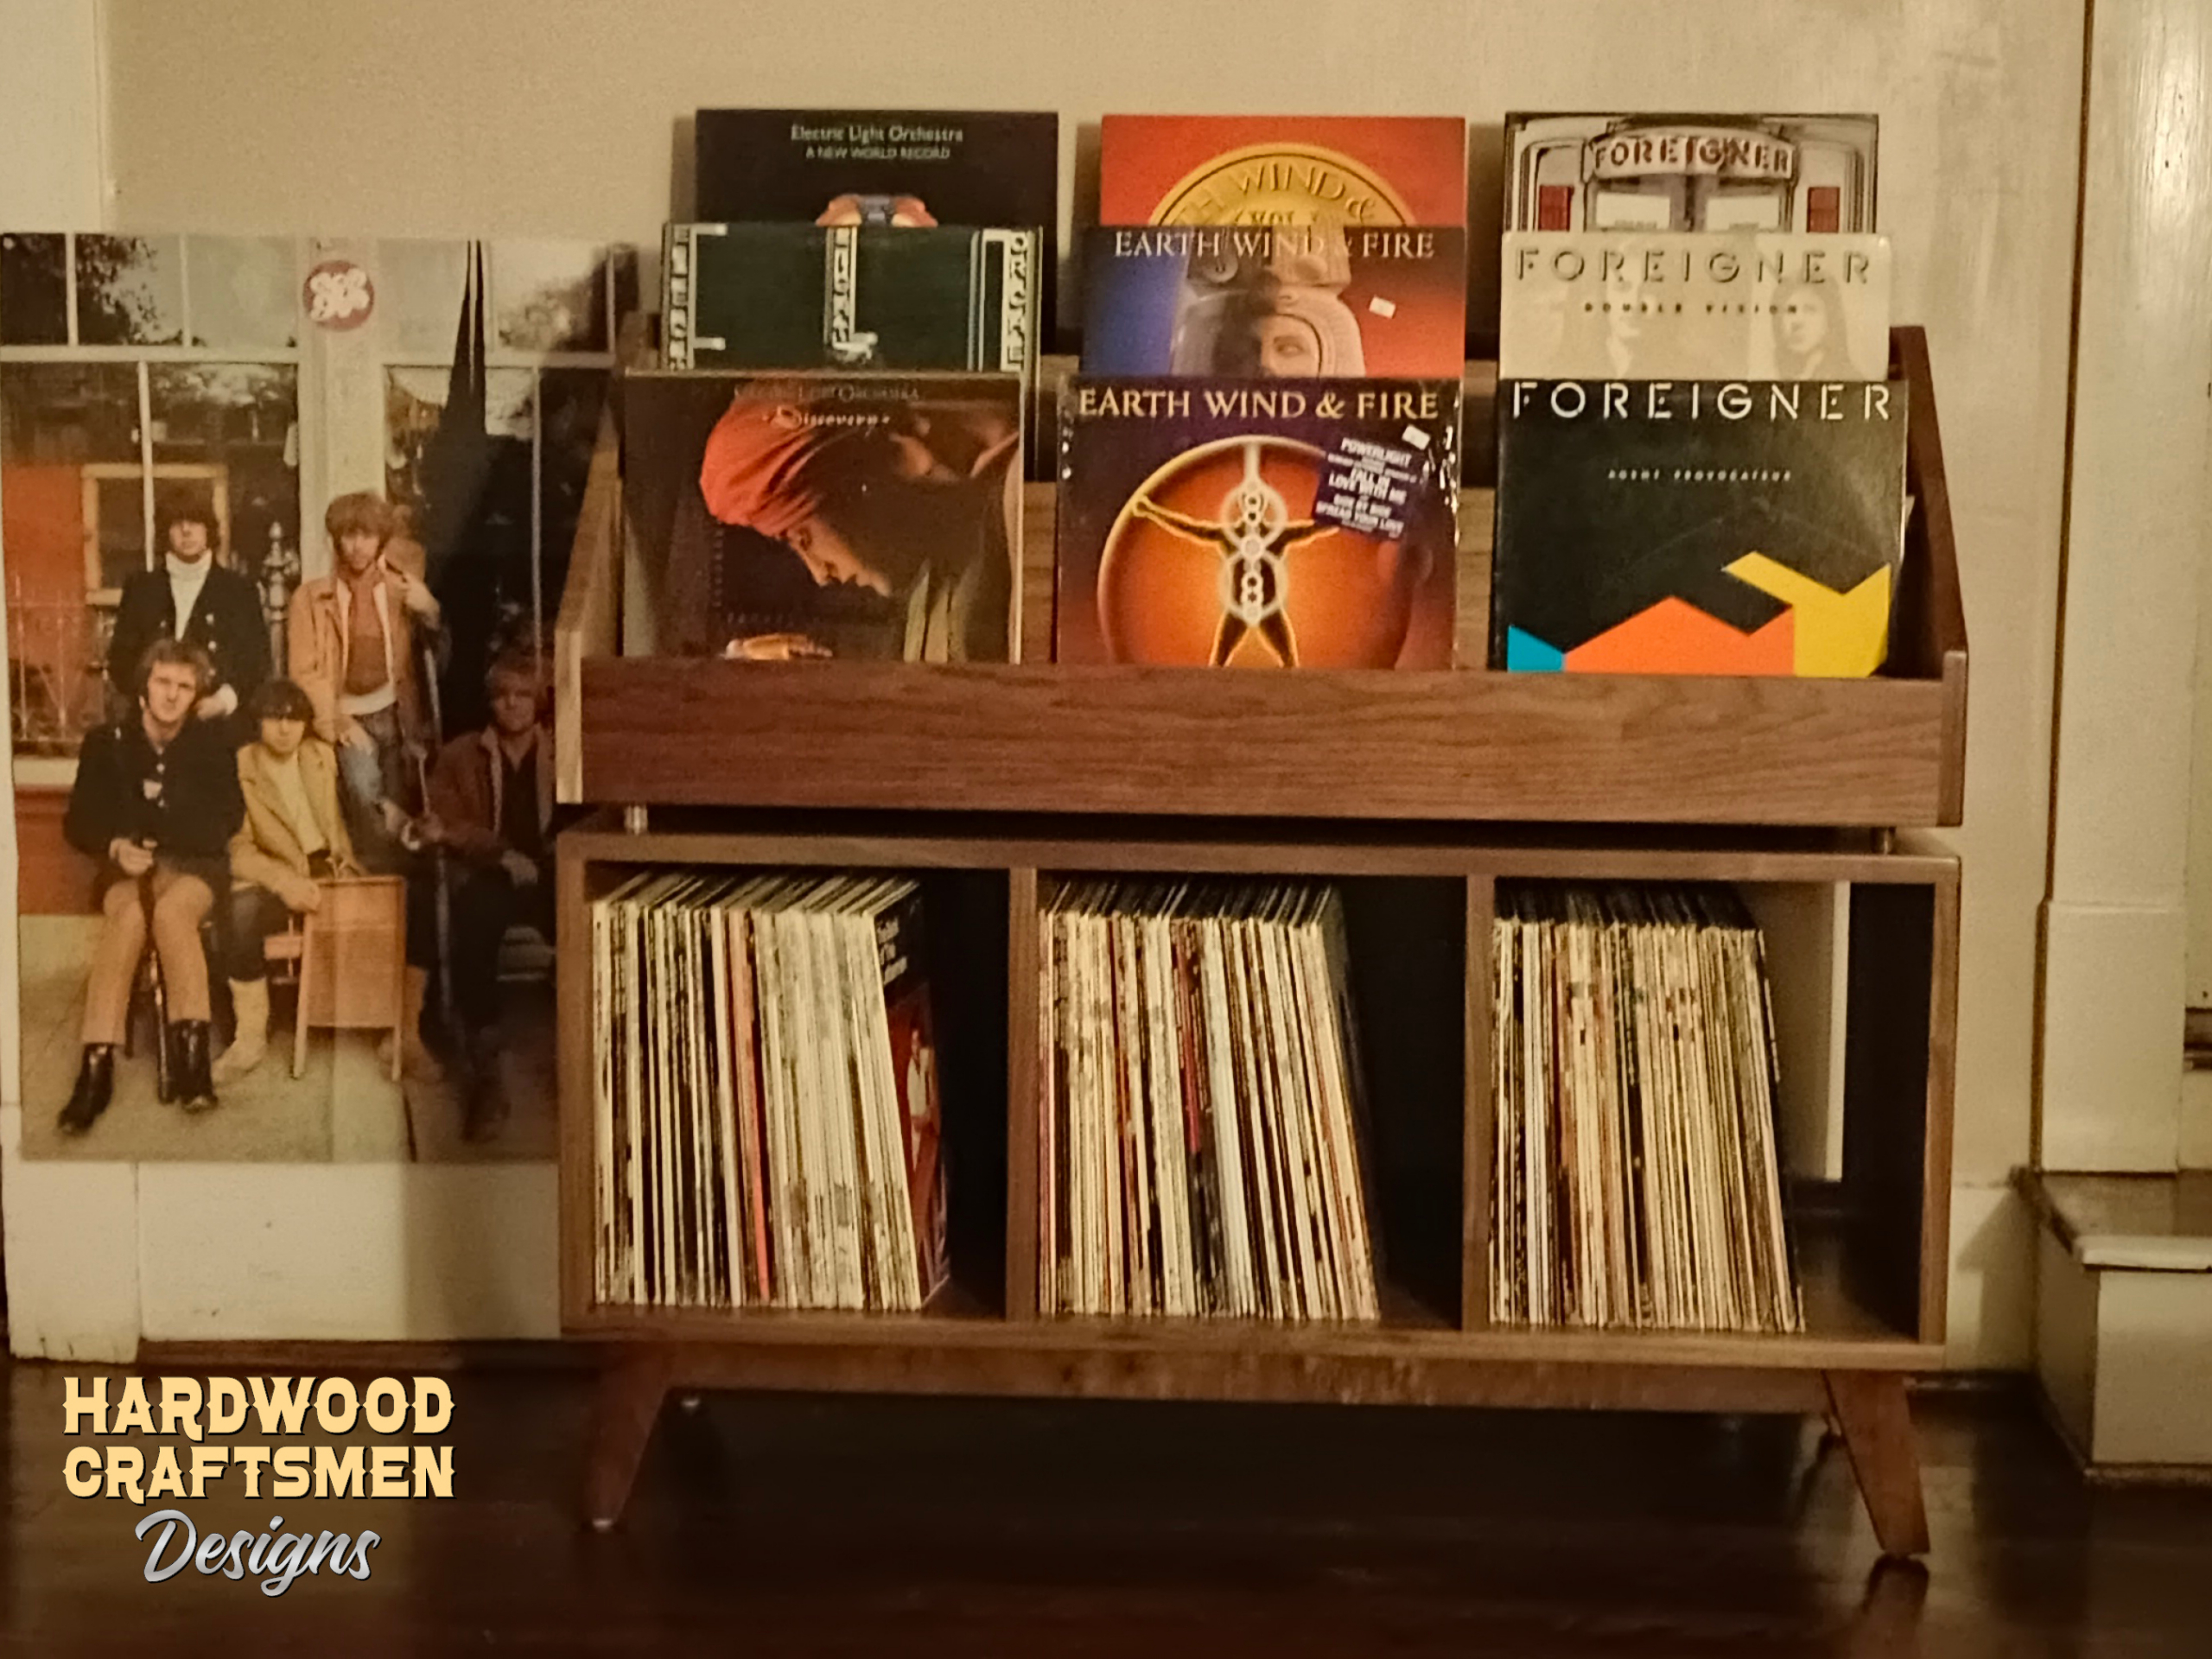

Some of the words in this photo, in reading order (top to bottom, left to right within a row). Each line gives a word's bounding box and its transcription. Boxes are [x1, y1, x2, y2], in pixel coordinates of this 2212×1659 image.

[791, 123, 843, 142] Electric
[849, 124, 885, 145] Light
[888, 125, 963, 142] Orchestra
[805, 146, 815, 159] A
[817, 146, 848, 159] NEW
[850, 146, 897, 159] WORLD
[900, 146, 950, 159] RECORD
[1595, 137, 1788, 173] FOREIGNER
[1228, 162, 1347, 201] WIND
[1115, 231, 1220, 257] EARTH
[1233, 231, 1325, 257] WIND
[1362, 232, 1434, 258] FIRE
[1516, 247, 1870, 284] FOREIGNER
[1078, 386, 1191, 418] EARTH
[1205, 389, 1306, 419] WIND
[1315, 391, 1345, 419] &
[1357, 391, 1439, 420] FIRE
[1513, 382, 1890, 420] FOREIGNER
